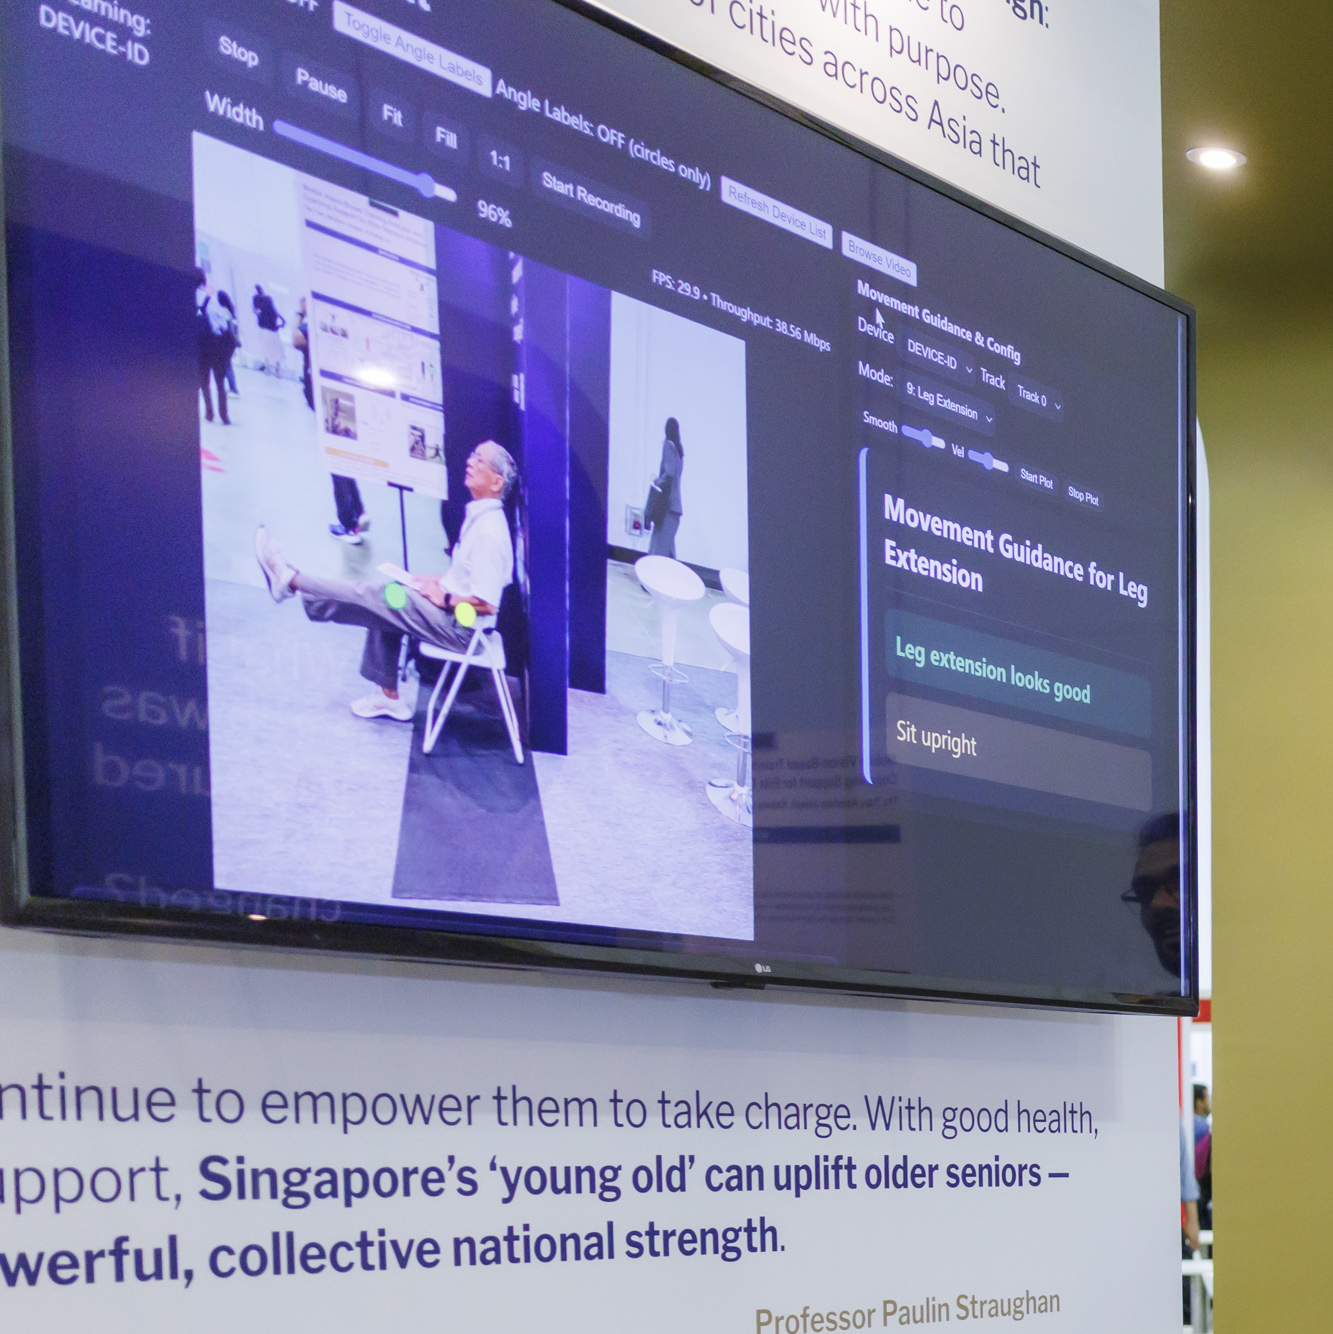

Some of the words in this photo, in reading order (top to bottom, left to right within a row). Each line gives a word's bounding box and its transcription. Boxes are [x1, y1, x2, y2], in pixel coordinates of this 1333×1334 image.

[39, 4, 150, 66] DEVICE-ID
[218, 35, 259, 68] Stop
[296, 67, 348, 103] Pause
[729, 0, 814, 66] cities
[823, 50, 919, 122] across
[927, 99, 983, 158] Asia
[989, 133, 1041, 189] that
[889, 24, 1006, 114] purpose.
[204, 89, 265, 131] Width
[496, 78, 541, 111] Angle
[545, 98, 594, 136] Labels:
[597, 124, 626, 150] OFF
[628, 138, 676, 173] (circles
[678, 163, 712, 191] only)
[477, 199, 513, 228] 96%
[541, 171, 574, 198] Start
[576, 185, 641, 229] Recording
[652, 268, 676, 290] FPS:
[677, 279, 701, 300] 29.9
[710, 292, 773, 329] Throughput:
[775, 319, 802, 341] 38.56
[804, 330, 831, 352] Mbps
[857, 279, 920, 320] Movement
[921, 308, 972, 342] Guidance
[974, 331, 985, 347] &
[986, 337, 1021, 366] Config
[858, 360, 894, 387] Mode:
[907, 338, 958, 370] DEVICE-ID
[980, 366, 1006, 391] Track
[1017, 384, 1040, 406] Track
[917, 385, 935, 406] Leg
[936, 393, 978, 421] Extension
[1020, 468, 1038, 485] Start
[1039, 474, 1054, 490] Plot
[1068, 485, 1084, 503] Stop
[1085, 491, 1099, 507] Plot
[883, 493, 994, 553] Movement
[998, 532, 1084, 582] Guidance
[1088, 561, 1115, 591] for
[1118, 571, 1149, 608] Leg
[884, 538, 984, 592] Extension
[896, 635, 926, 668] Leg
[930, 649, 1007, 683] extension
[1010, 664, 1050, 694] looks
[1053, 679, 1091, 704] good
[896, 719, 917, 744] Sit
[921, 726, 977, 758] upright
[191, 1077, 245, 1124] to
[261, 1089, 481, 1134] empower
[491, 1084, 598, 1128] them
[609, 1088, 647, 1128] to
[657, 1089, 735, 1129] take
[745, 1091, 857, 1139] charge.
[864, 1094, 933, 1132] With
[941, 1099, 1009, 1139] good
[1017, 1099, 1099, 1140] health,
[0, 1155, 181, 1214] pport,
[199, 1154, 479, 1210] Singapore’s
[489, 1155, 622, 1204] ‘young
[632, 1154, 695, 1193] old’
[705, 1164, 764, 1193] can
[773, 1154, 857, 1198] uplift
[865, 1154, 939, 1189] older
[945, 1154, 1042, 1188] seniors
[208, 1228, 441, 1278] collective
[452, 1220, 615, 1267] national
[625, 1216, 786, 1262] strength.
[883, 1296, 950, 1327] Paulin
[956, 1289, 1061, 1321] Straughan
